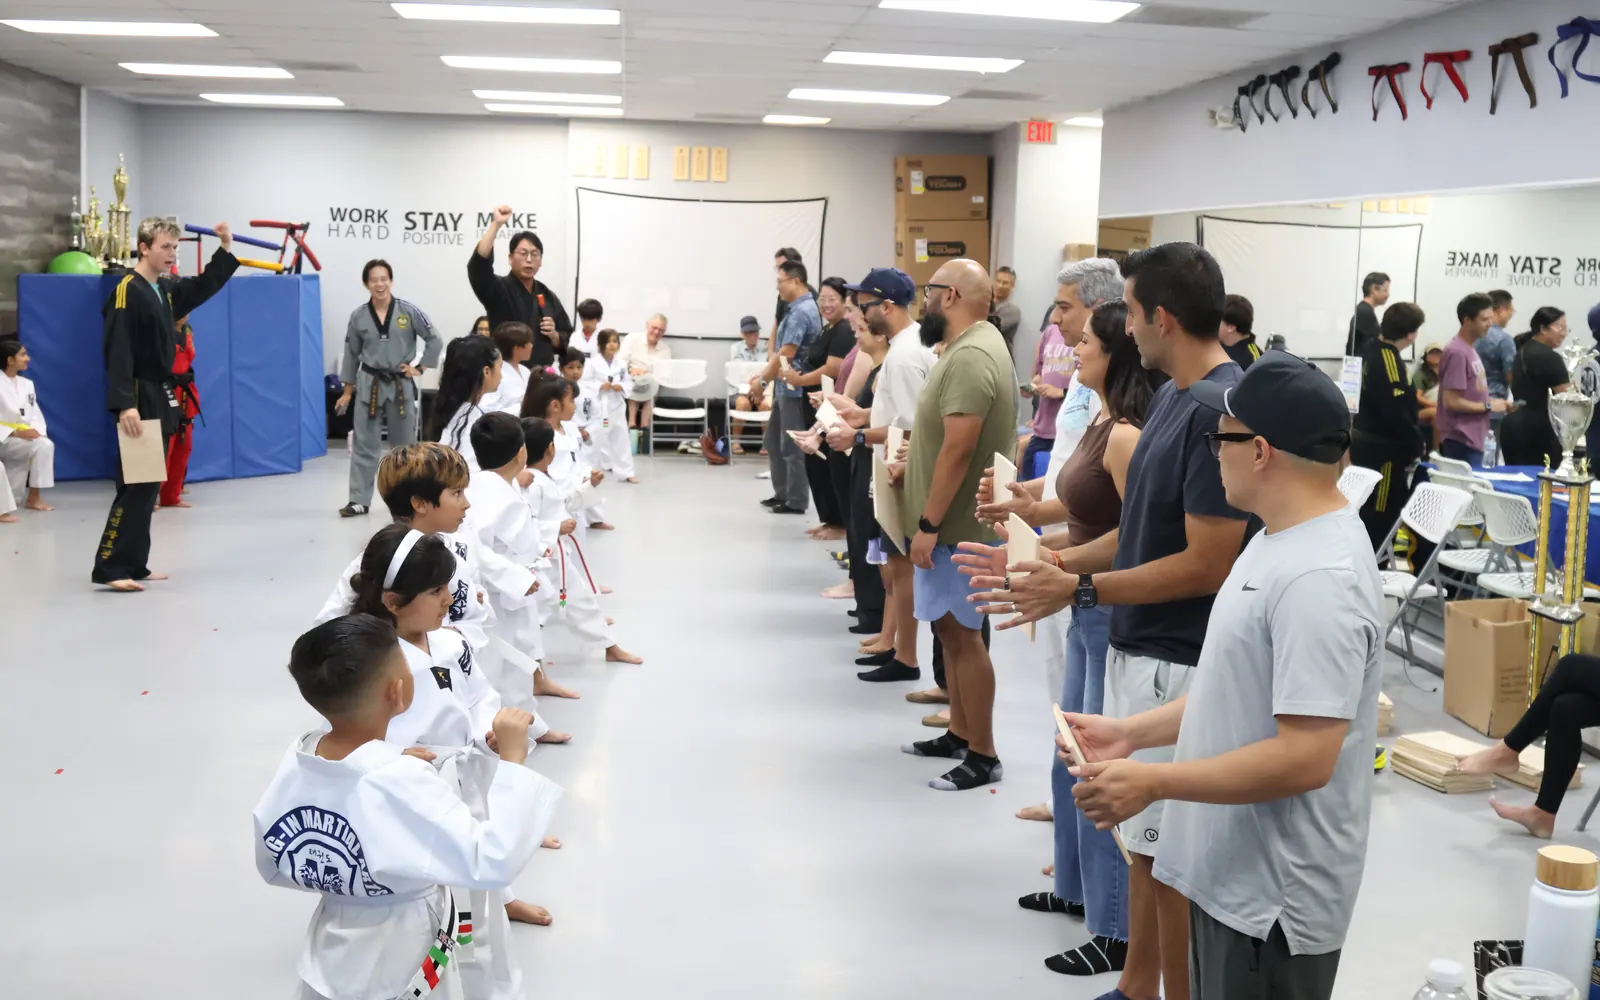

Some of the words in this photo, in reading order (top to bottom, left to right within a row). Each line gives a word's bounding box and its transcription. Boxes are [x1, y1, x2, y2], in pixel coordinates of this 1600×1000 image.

[1027, 121, 1053, 142] EXIT
[329, 207, 389, 224] WORK
[404, 211, 463, 231] STAY
[476, 212, 538, 229] MKE
[328, 223, 390, 240] HARD
[403, 231, 464, 245] POSITIVE
[301, 808, 361, 857] MARTIAL
[358, 858, 389, 896] ARTS
